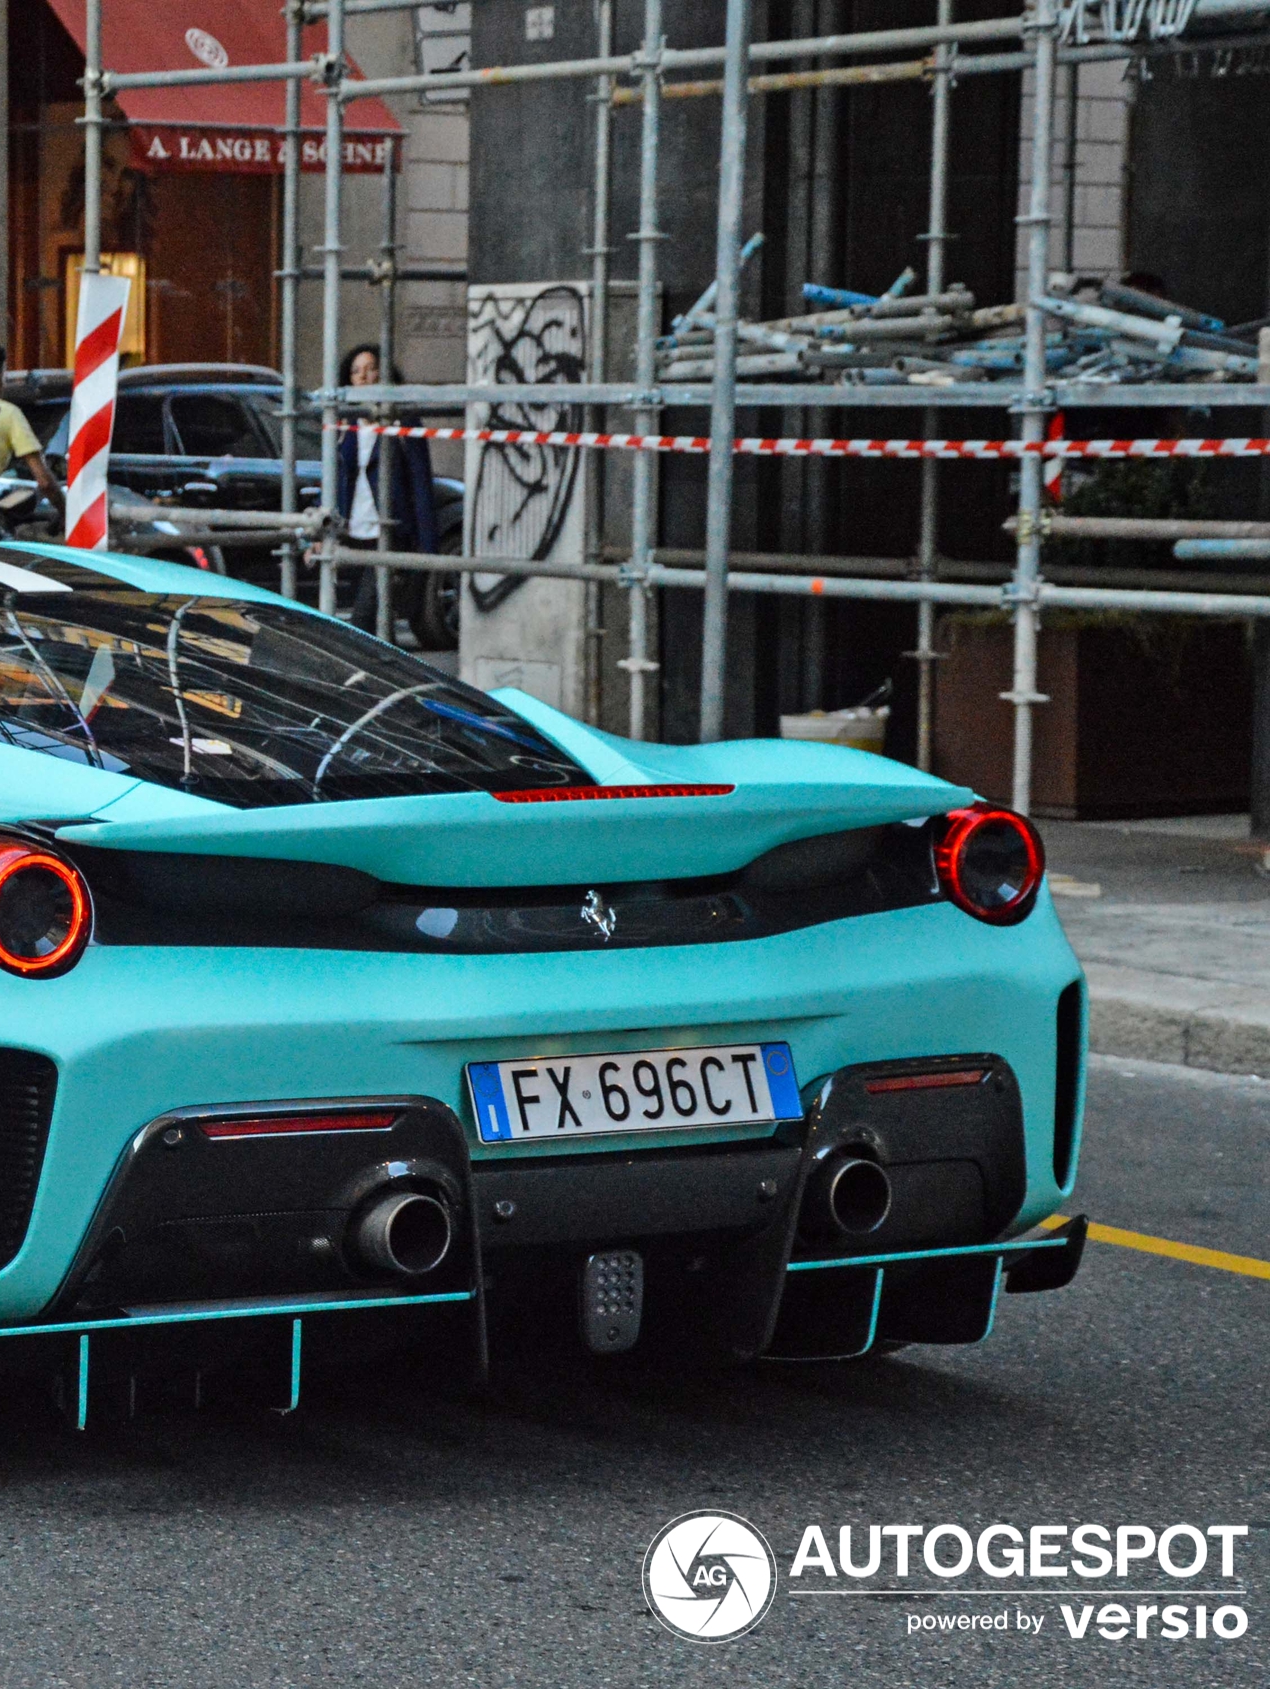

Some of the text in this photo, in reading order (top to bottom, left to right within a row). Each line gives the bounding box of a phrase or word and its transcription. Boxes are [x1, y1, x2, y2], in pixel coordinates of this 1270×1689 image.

[179, 136, 270, 162] LANGE
[511, 1066, 583, 1131] FX
[598, 1053, 758, 1122] 696CT
